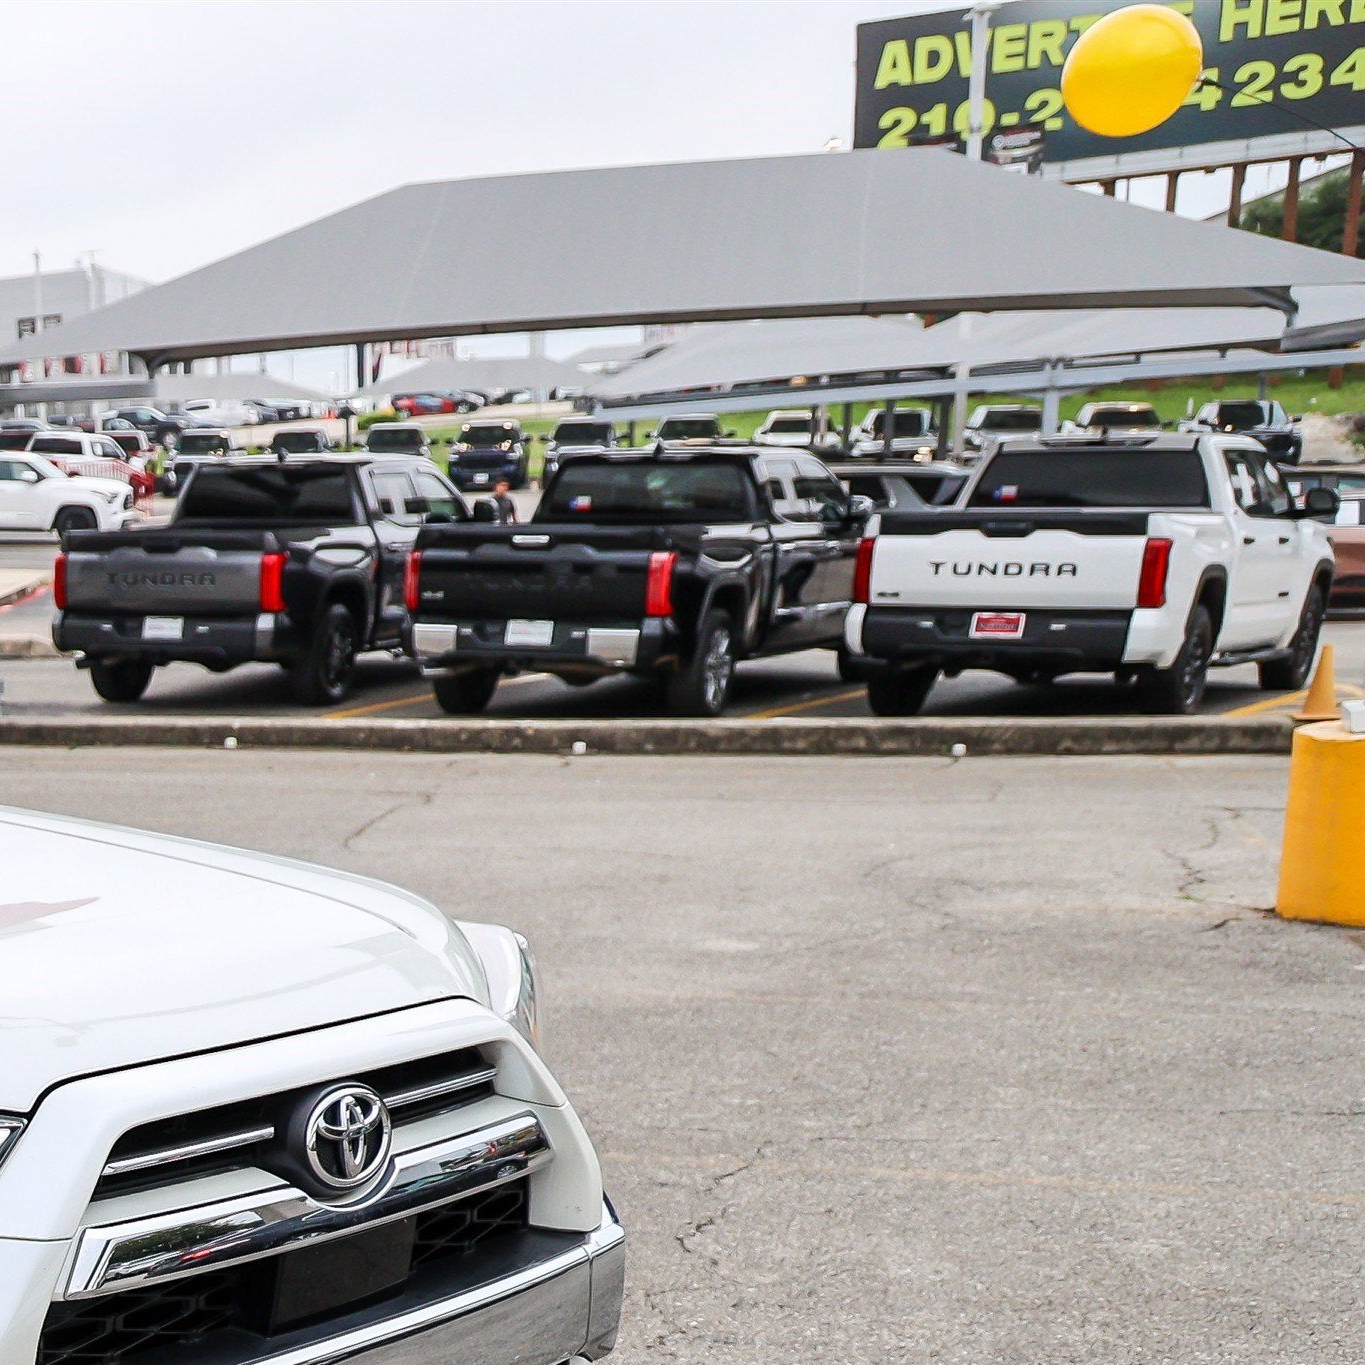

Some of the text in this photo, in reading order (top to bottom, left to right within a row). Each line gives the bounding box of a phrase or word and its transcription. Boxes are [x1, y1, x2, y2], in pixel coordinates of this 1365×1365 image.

[1220, 0, 1365, 43] HER
[930, 562, 1077, 576] TUNDRA
[107, 573, 216, 586] TUNDRA
